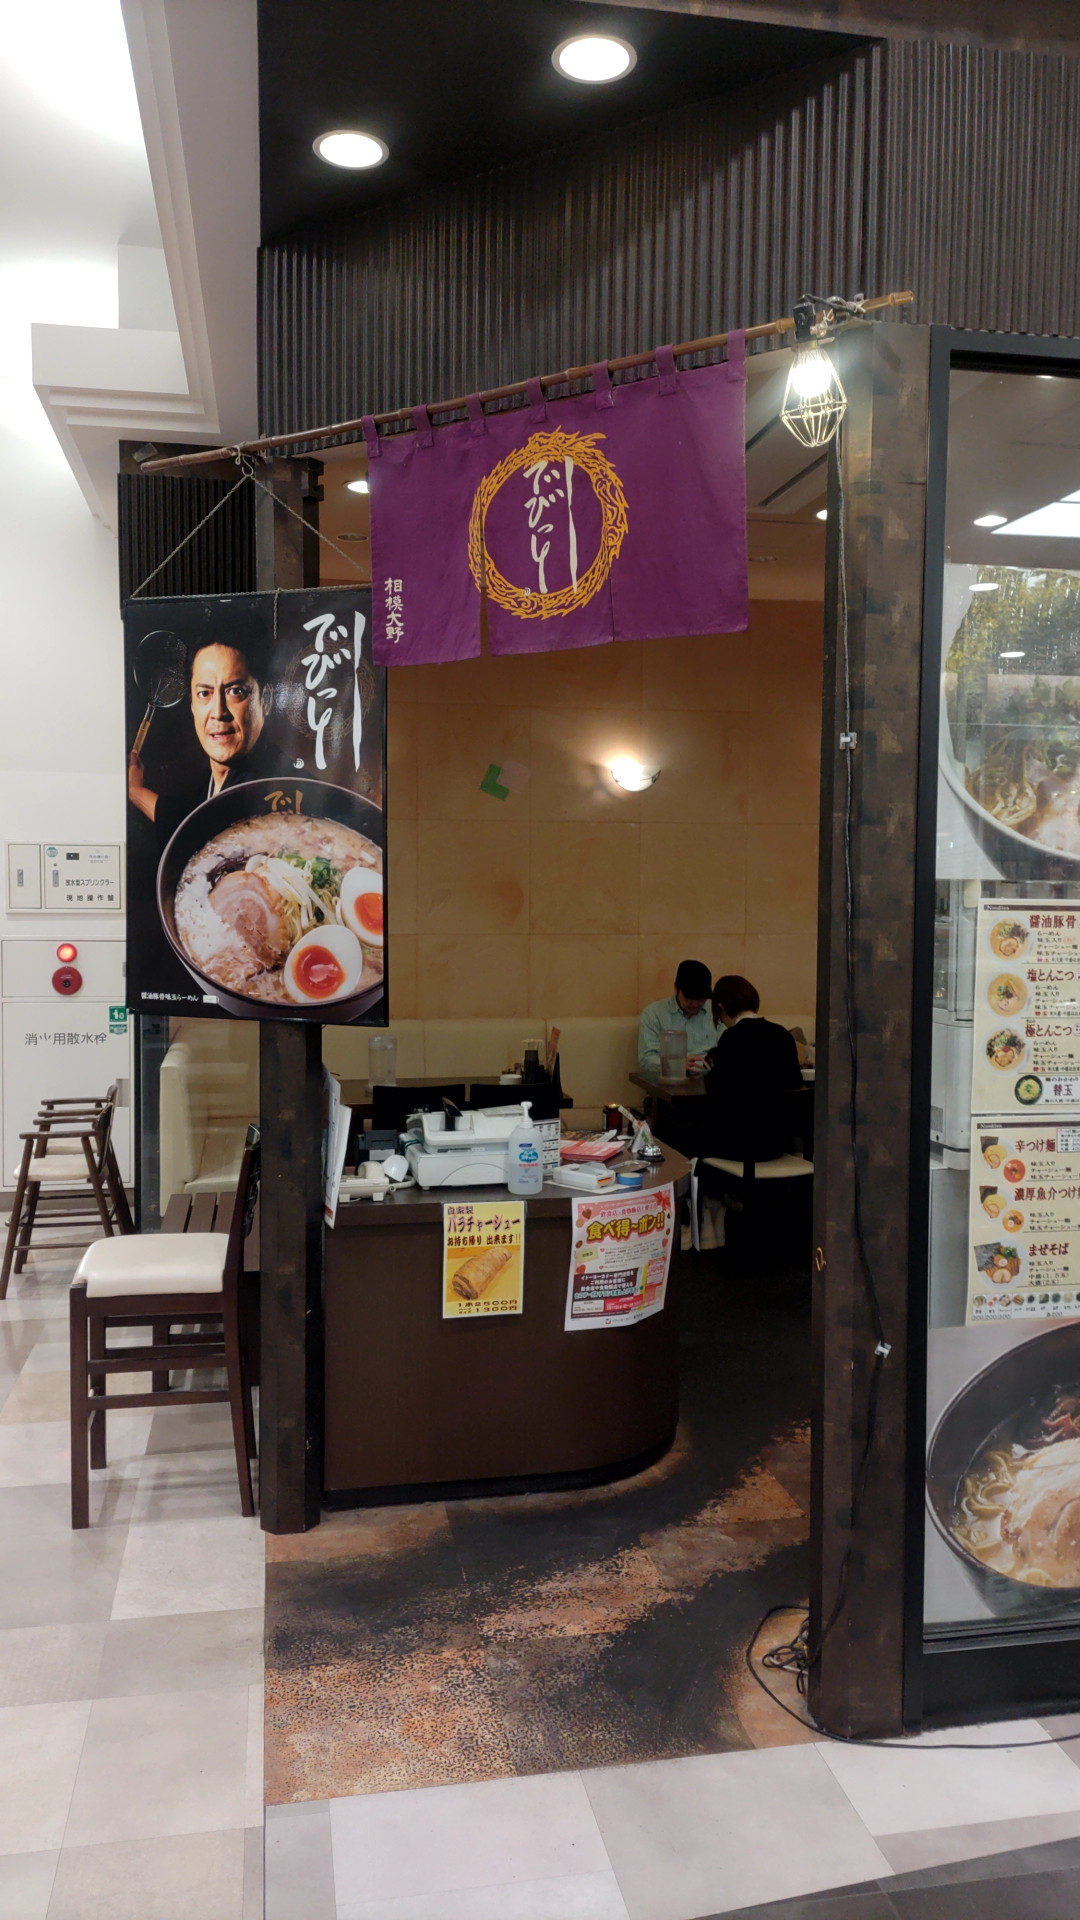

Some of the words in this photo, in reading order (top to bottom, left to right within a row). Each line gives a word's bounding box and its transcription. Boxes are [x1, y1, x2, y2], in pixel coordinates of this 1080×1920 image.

[385, 577, 404, 644] 相模大野
[65, 879, 115, 887] 放水型スプリンクラー
[66, 894, 114, 902] 現地操作盤
[1029, 914, 1077, 929] 醤油豚骨
[1027, 968, 1075, 982] 塩とんこつ
[1025, 1023, 1073, 1038] 極とんこつ
[1053, 1084, 1073, 1097] 替玉
[1015, 1139, 1056, 1153] 辛つけ麺
[1014, 1186, 1080, 1201] 濃厚魚介つけ
[447, 1206, 474, 1215] 自家製
[447, 1235, 482, 1246] お持ち帰り
[1028, 1243, 1069, 1256] まぜそば
